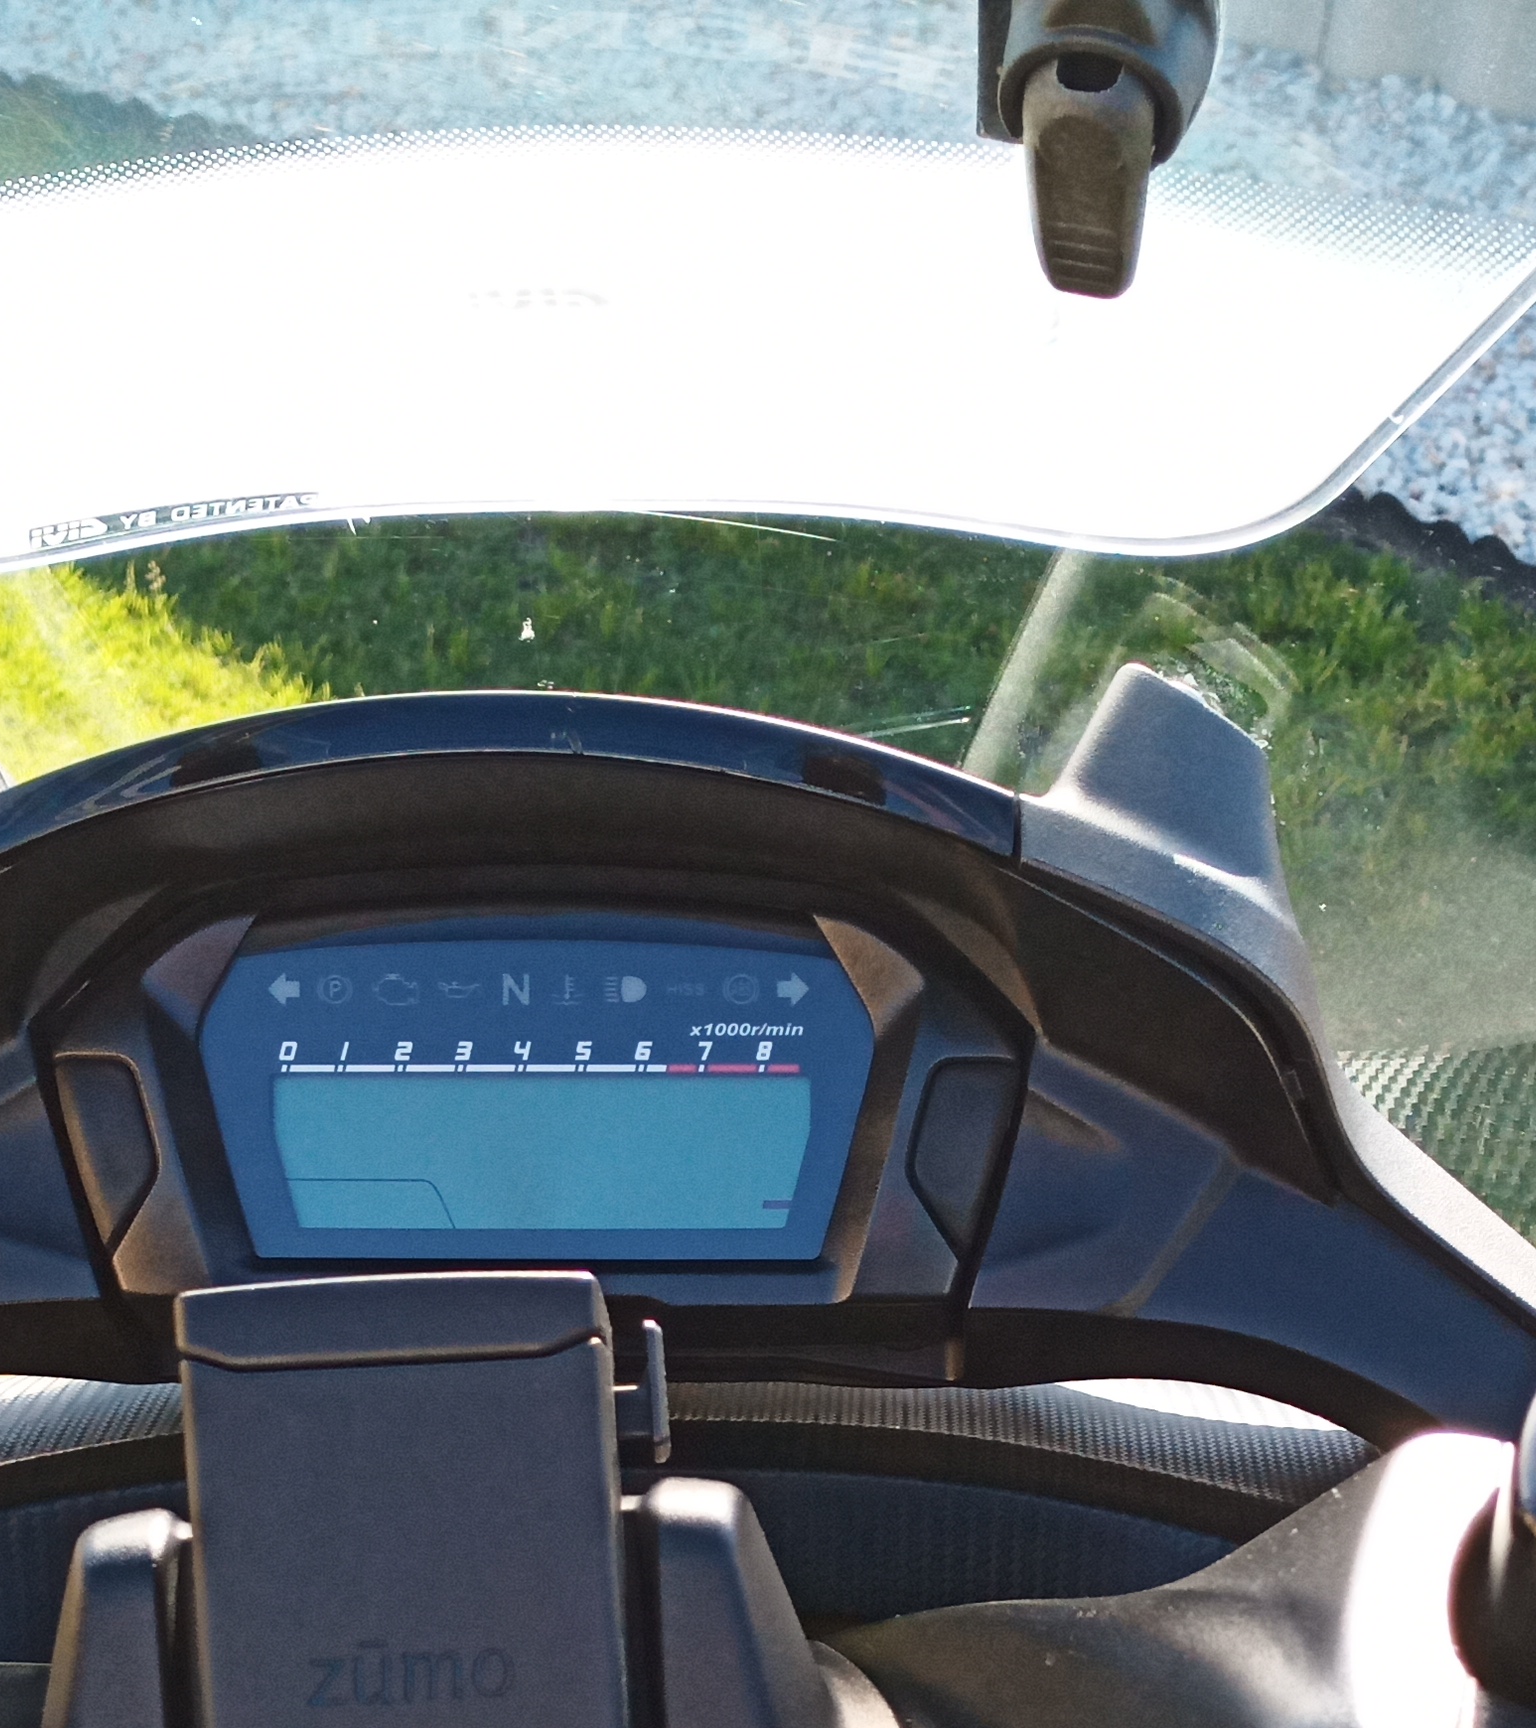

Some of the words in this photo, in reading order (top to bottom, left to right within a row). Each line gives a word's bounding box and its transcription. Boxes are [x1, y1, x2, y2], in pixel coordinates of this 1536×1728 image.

[501, 973, 531, 1006] N
[689, 1021, 804, 1040] x1000r/min
[279, 1041, 298, 1061] 0
[340, 1041, 350, 1061] 1
[394, 1041, 413, 1061] 2
[455, 1041, 473, 1061] 3
[513, 1041, 532, 1061] 4
[574, 1041, 592, 1061] 5
[634, 1041, 653, 1061] 6
[697, 1041, 714, 1061] 7
[755, 1041, 773, 1061] 8
[306, 1638, 518, 1708] zūmo
